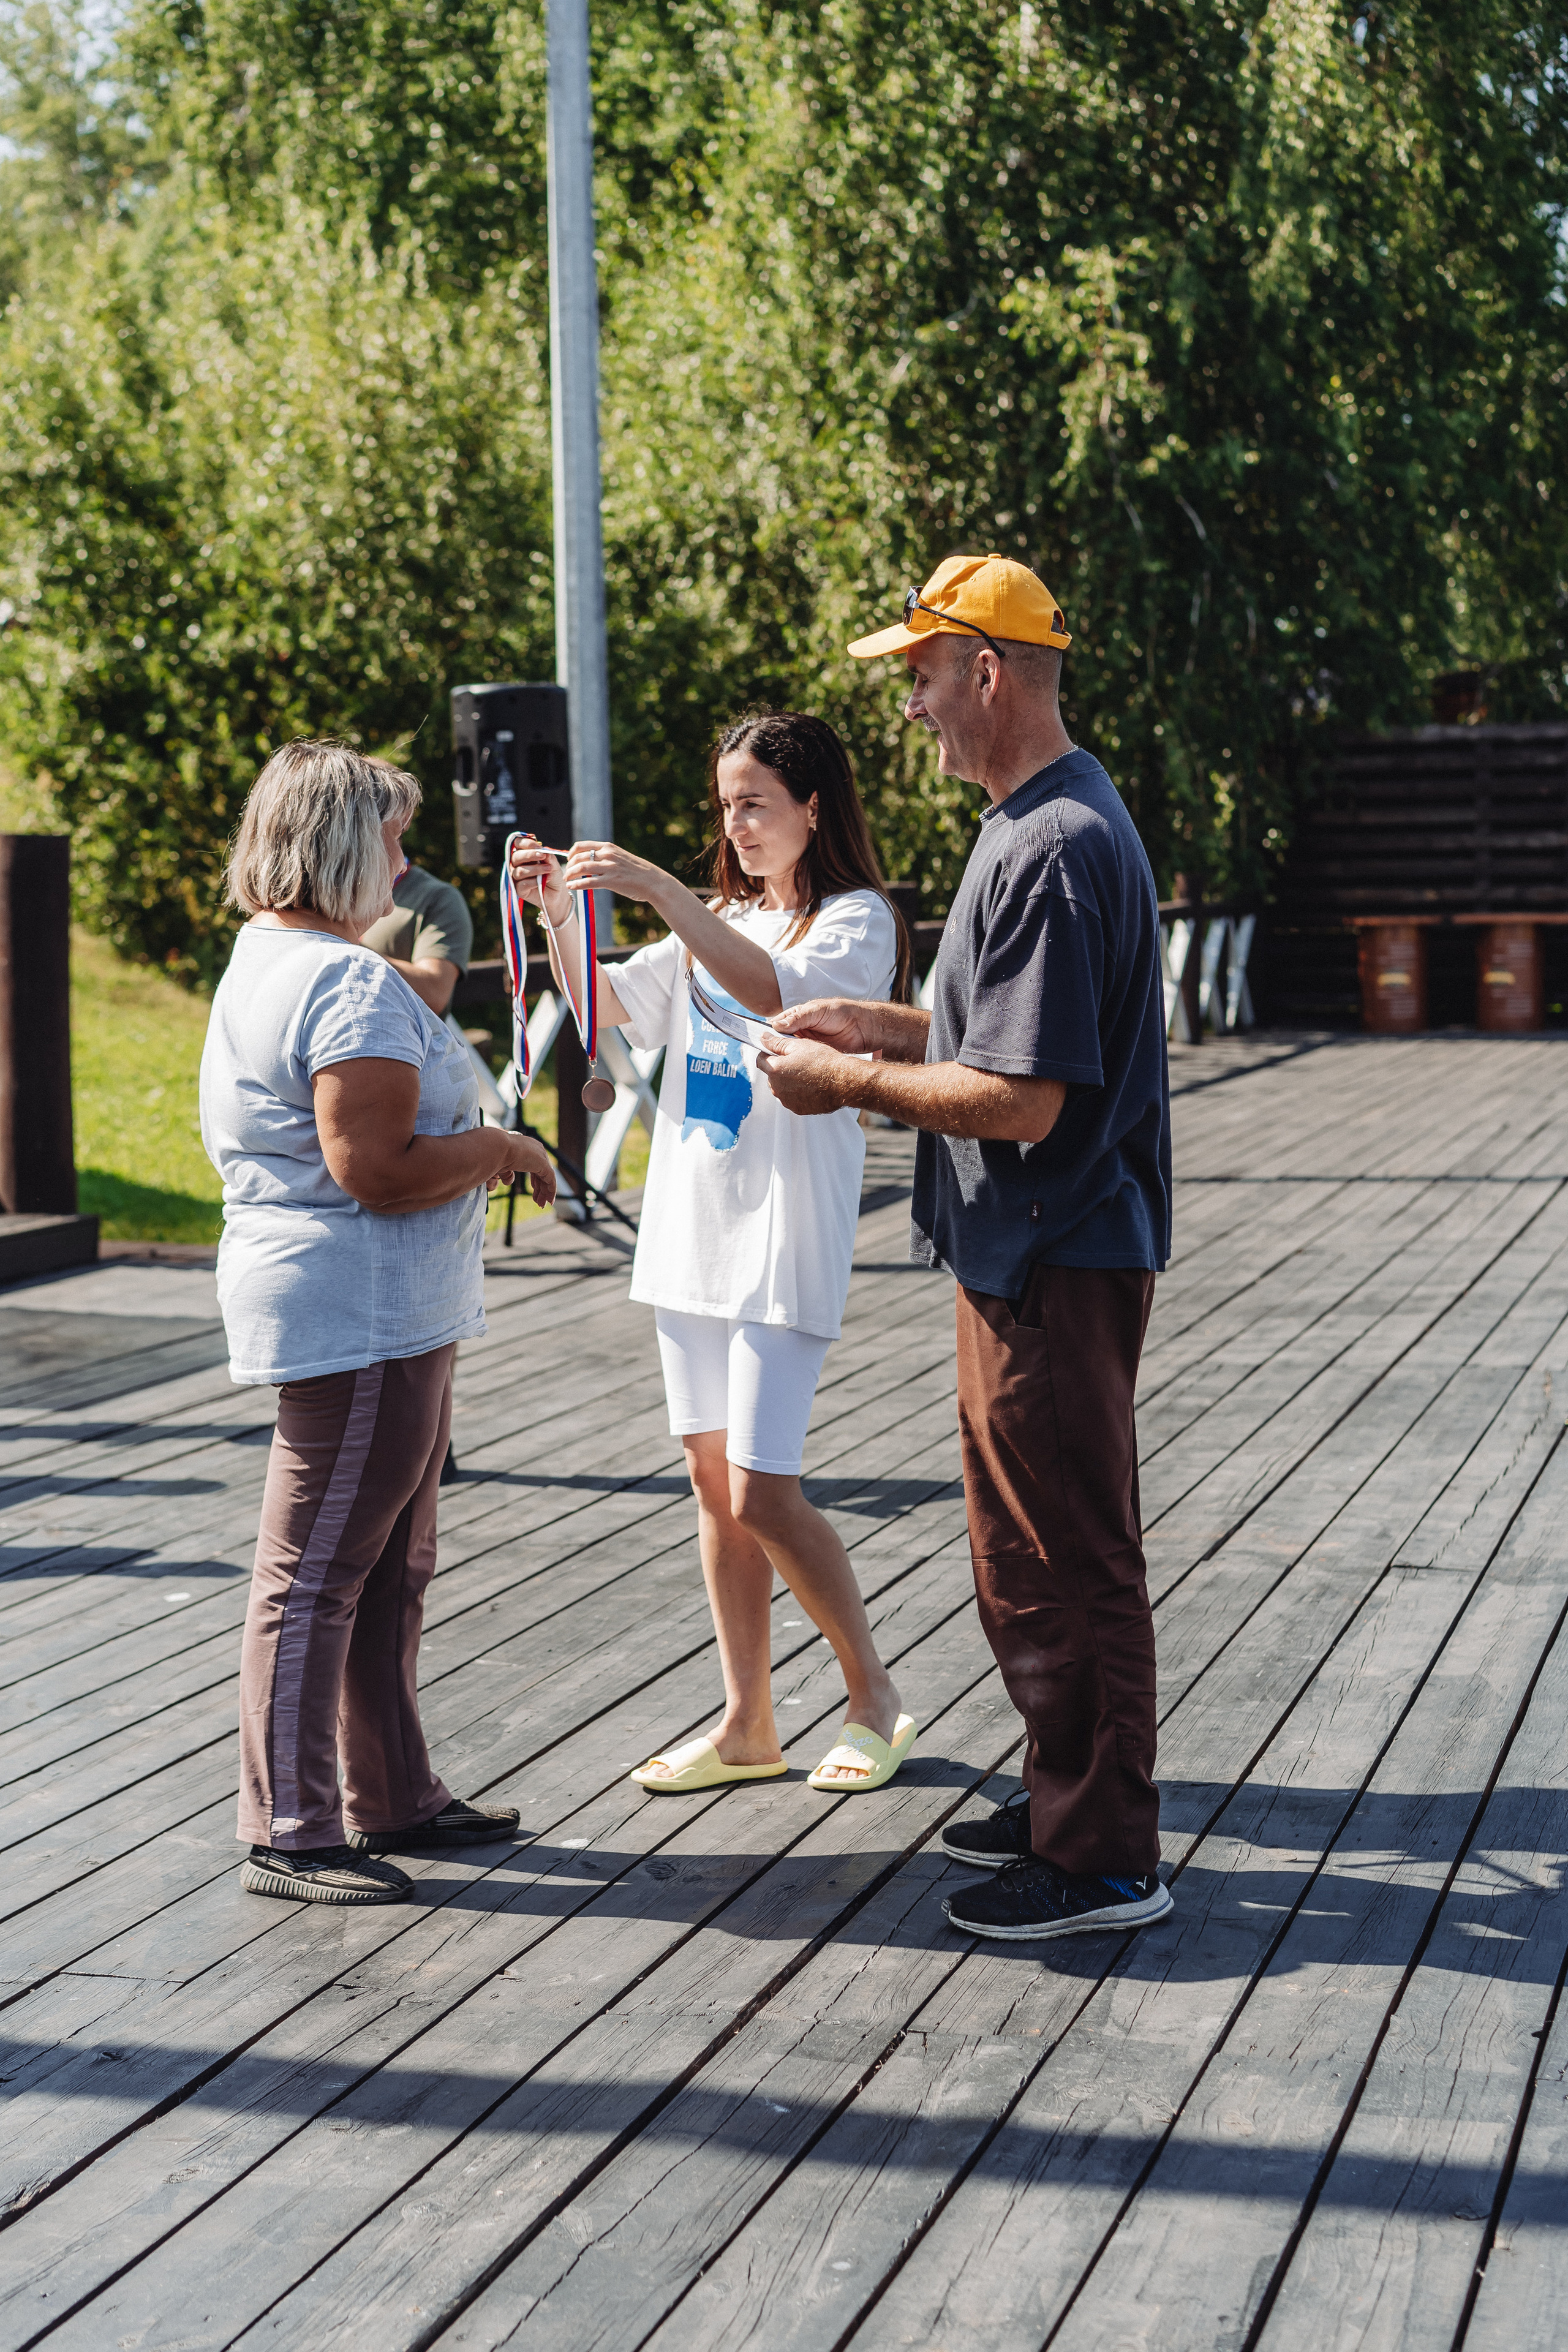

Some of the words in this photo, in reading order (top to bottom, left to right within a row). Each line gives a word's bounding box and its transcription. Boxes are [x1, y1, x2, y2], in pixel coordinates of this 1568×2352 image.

[703, 1039, 729, 1055] FORCE
[690, 1058, 711, 1074] LOEN
[712, 1062, 737, 1078] BALIN
